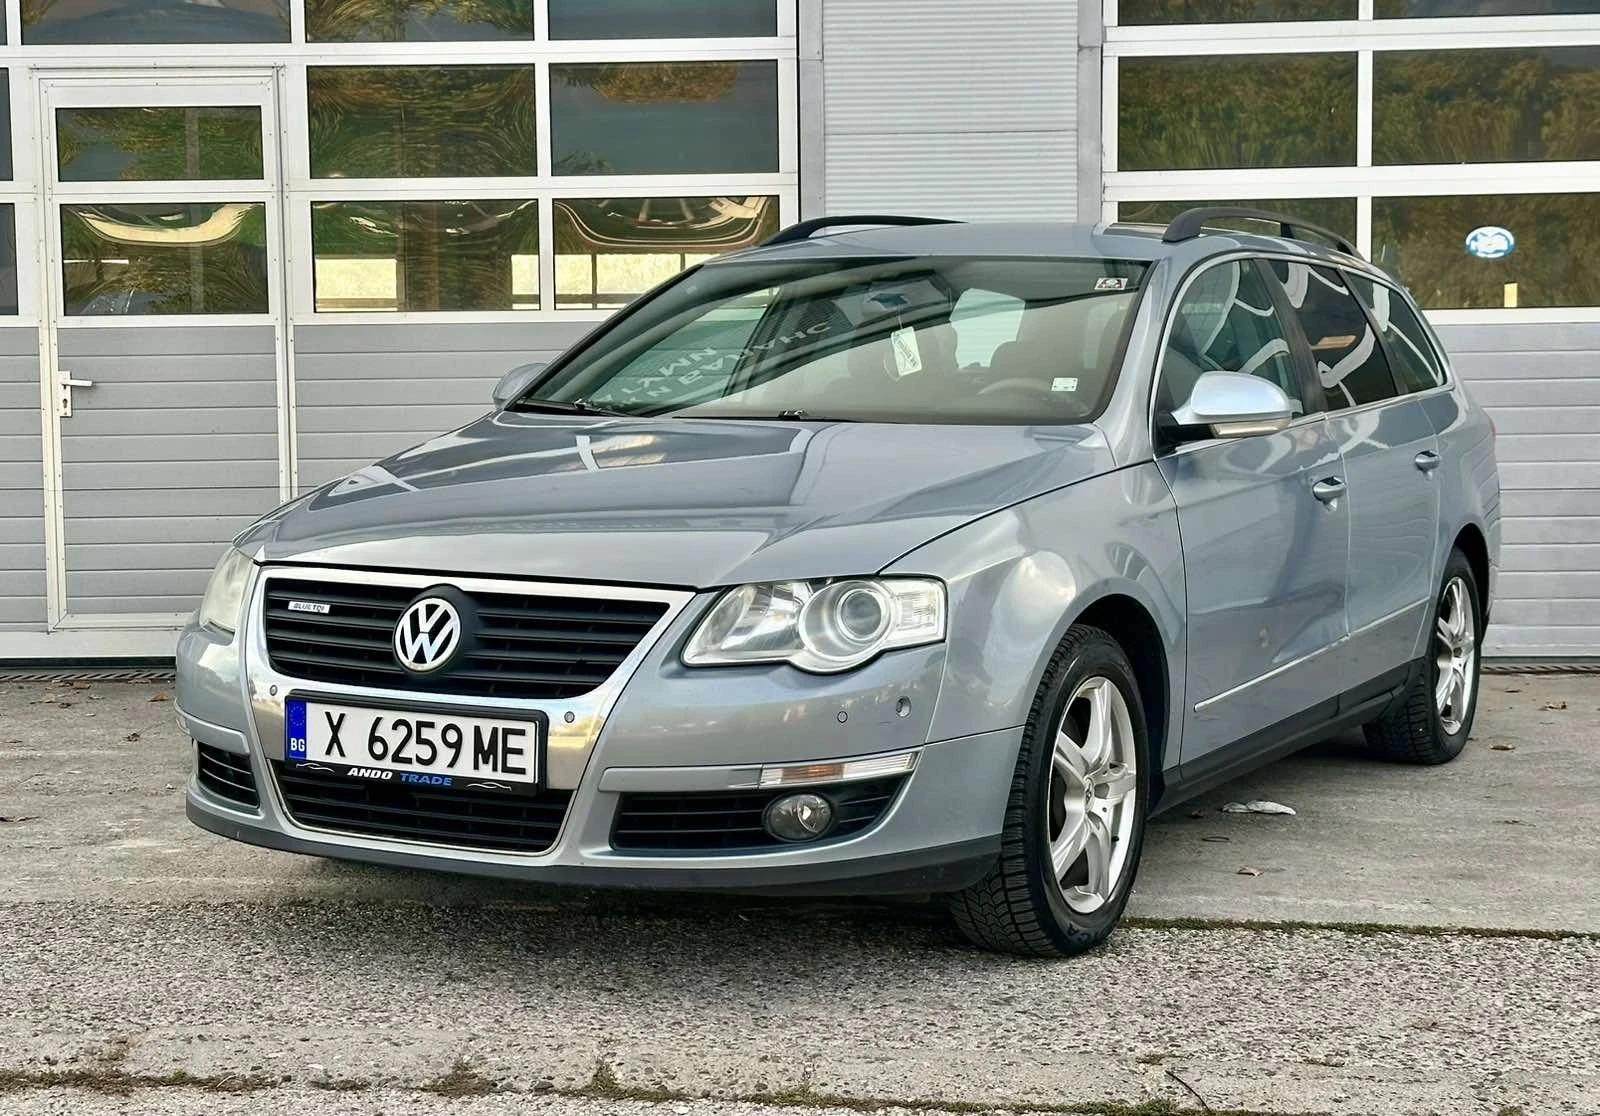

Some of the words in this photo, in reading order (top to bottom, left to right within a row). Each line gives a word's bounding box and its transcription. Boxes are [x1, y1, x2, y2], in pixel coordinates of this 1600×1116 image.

[290, 737, 306, 752] BG
[324, 711, 346, 758] X
[367, 716, 463, 768] 6259
[472, 725, 527, 775] ME
[347, 767, 393, 780] ANDO
[400, 773, 453, 787] TRADE
